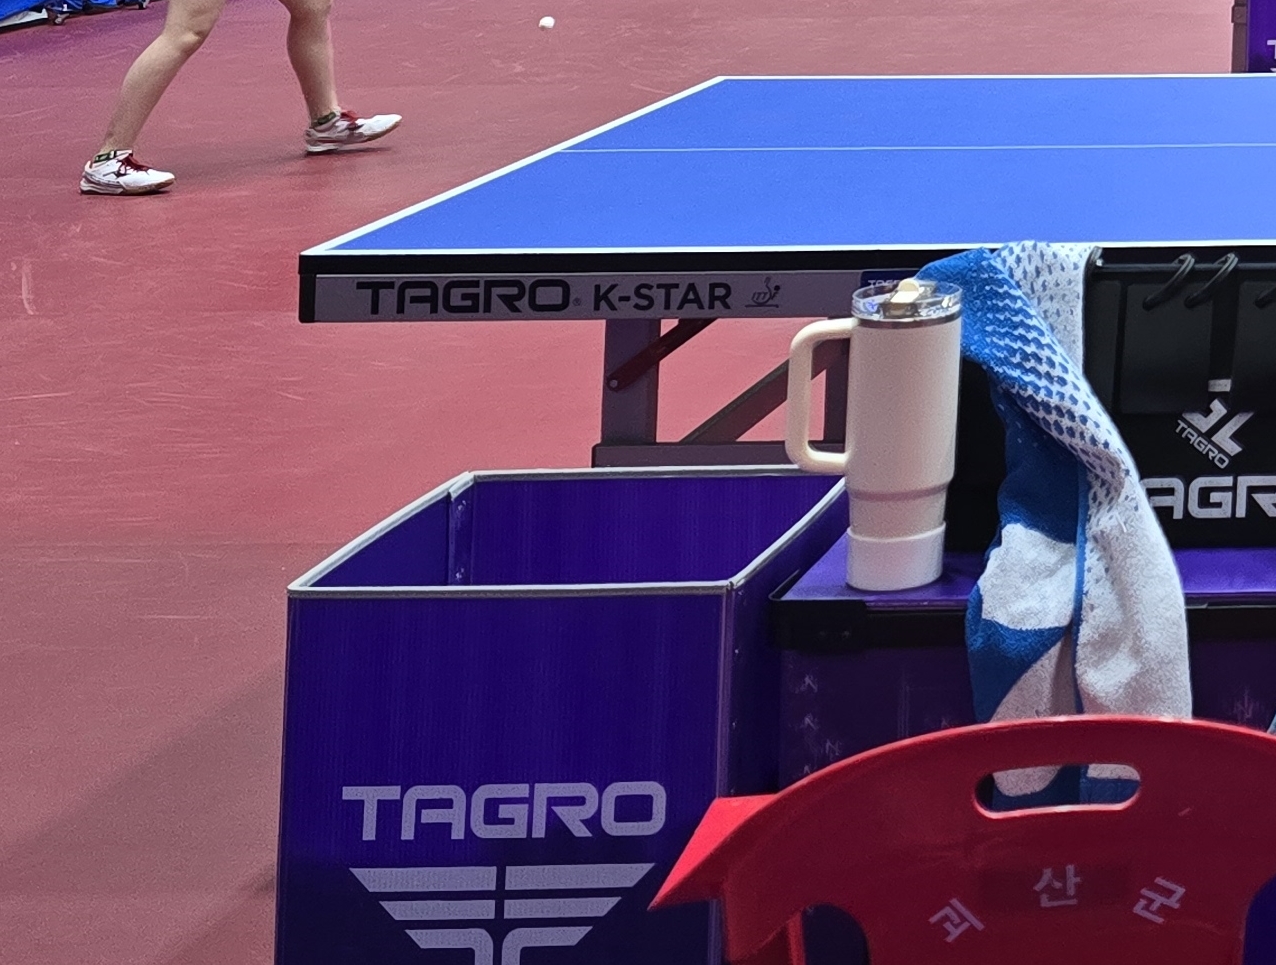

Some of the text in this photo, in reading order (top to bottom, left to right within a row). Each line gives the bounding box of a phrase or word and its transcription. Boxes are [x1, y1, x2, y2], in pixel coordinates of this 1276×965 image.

[355, 278, 572, 315] TAGRO
[593, 282, 733, 313] K-STAR
[1175, 419, 1230, 469] TAGRO
[342, 780, 668, 841] TAGRO
